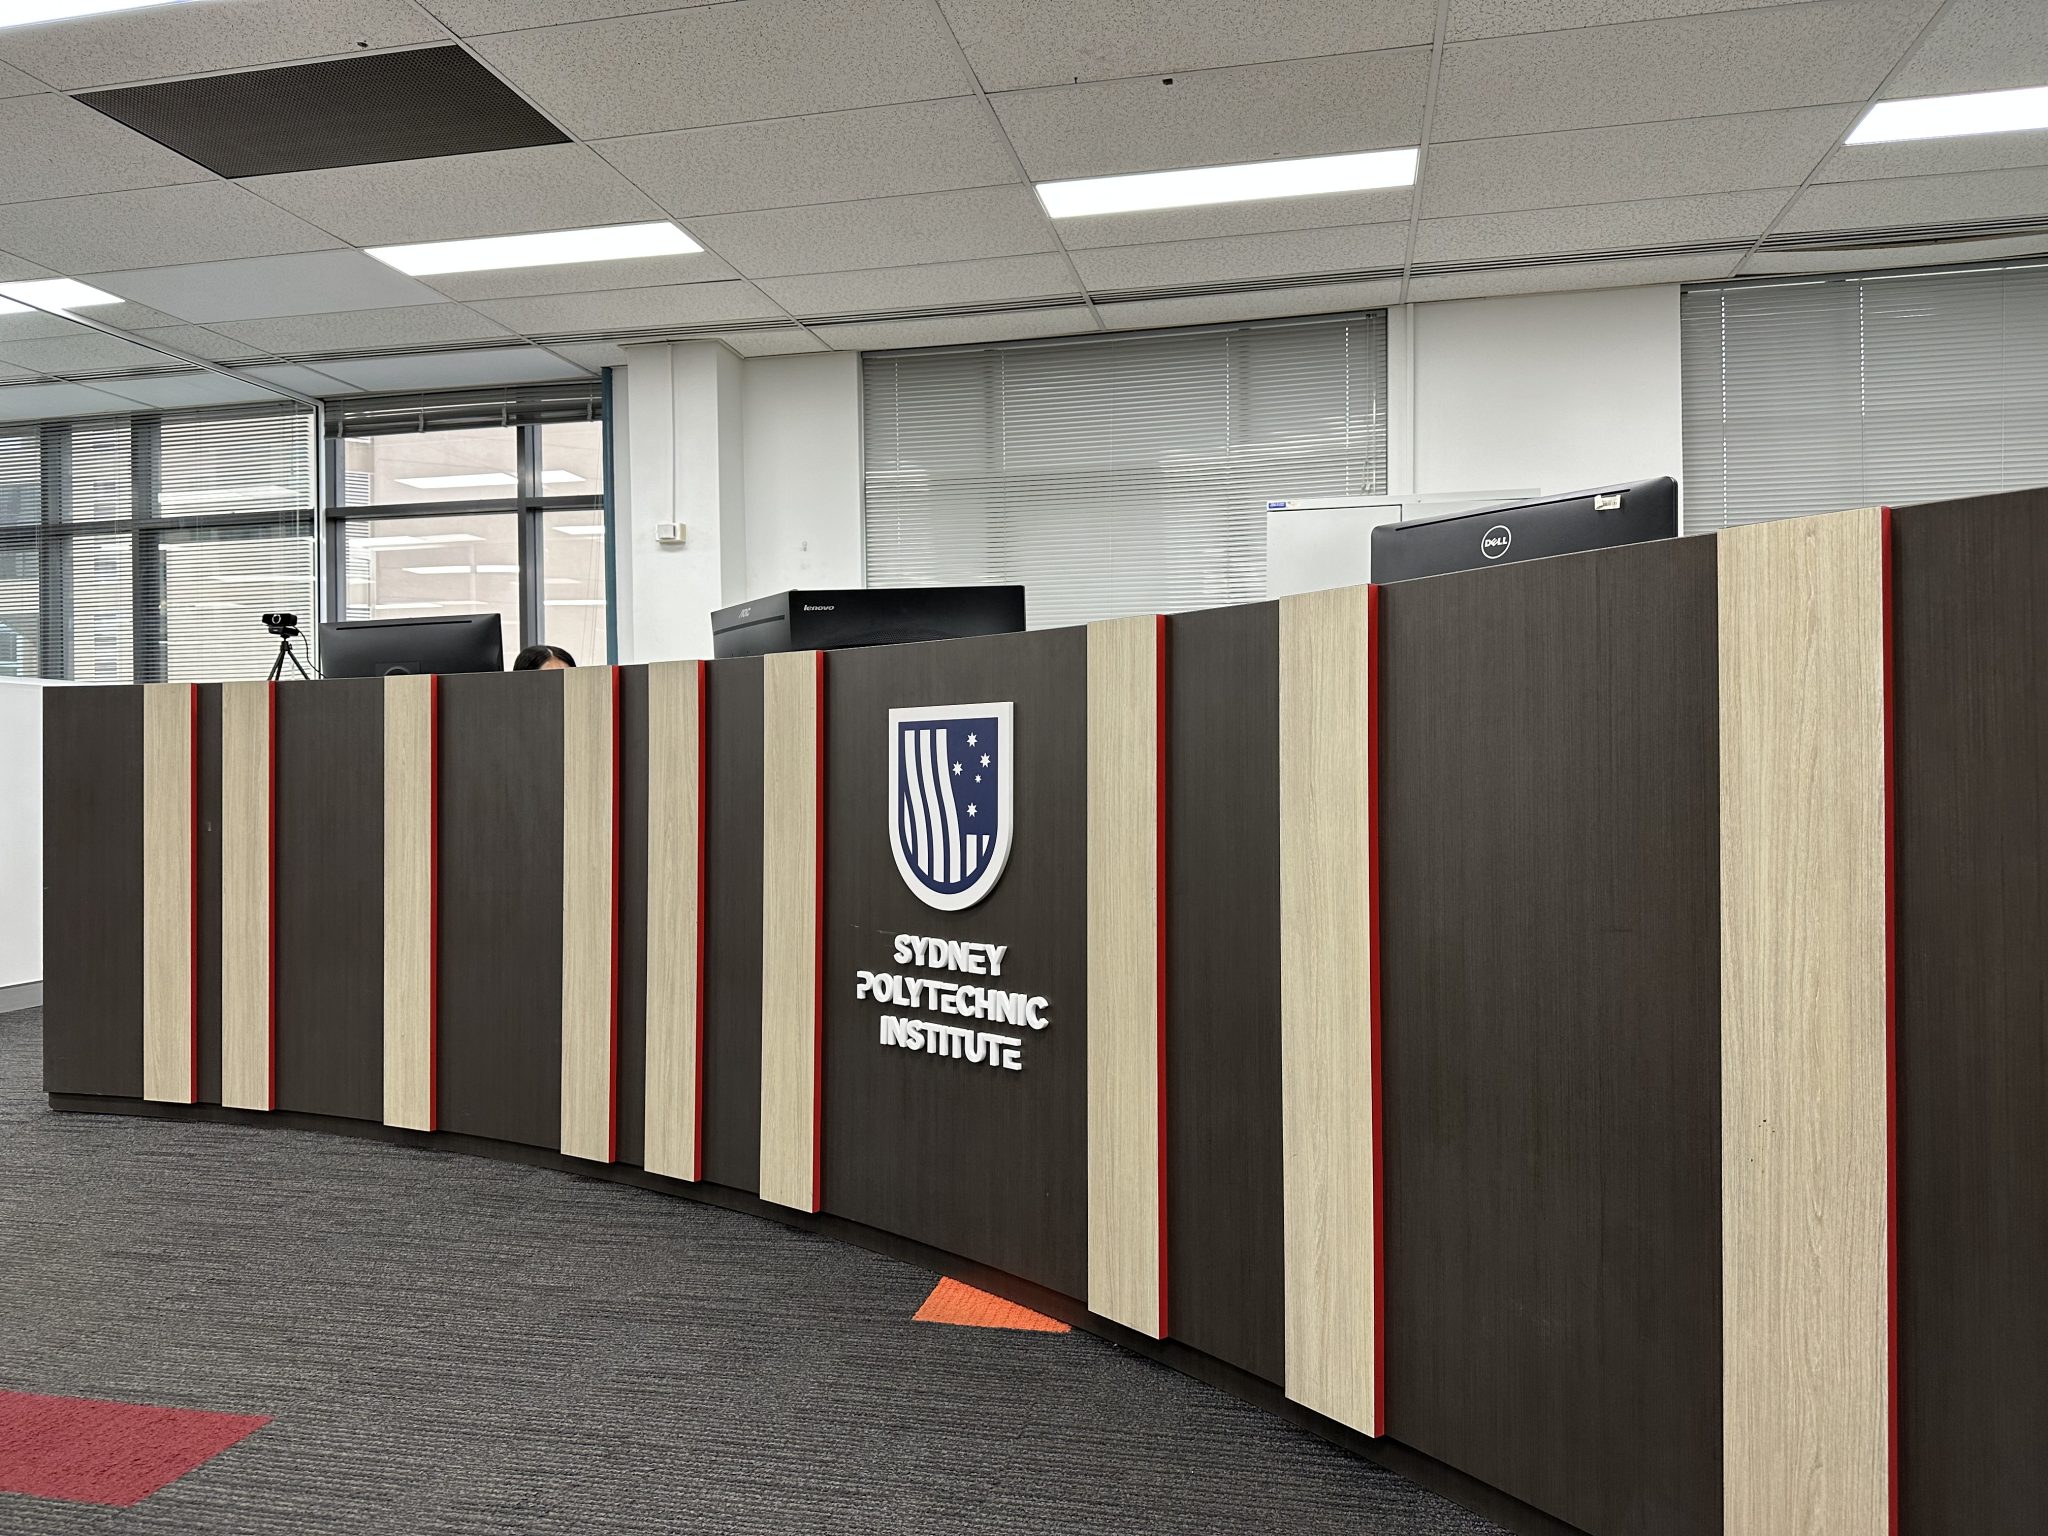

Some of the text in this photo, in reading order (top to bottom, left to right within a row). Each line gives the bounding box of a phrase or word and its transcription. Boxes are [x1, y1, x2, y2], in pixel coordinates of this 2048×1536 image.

[1484, 536, 1508, 548] DELL
[893, 934, 1008, 976] SYDNEY
[856, 970, 1049, 1030] POLYTECHNIC
[879, 1014, 1022, 1071] INSTITUTE
